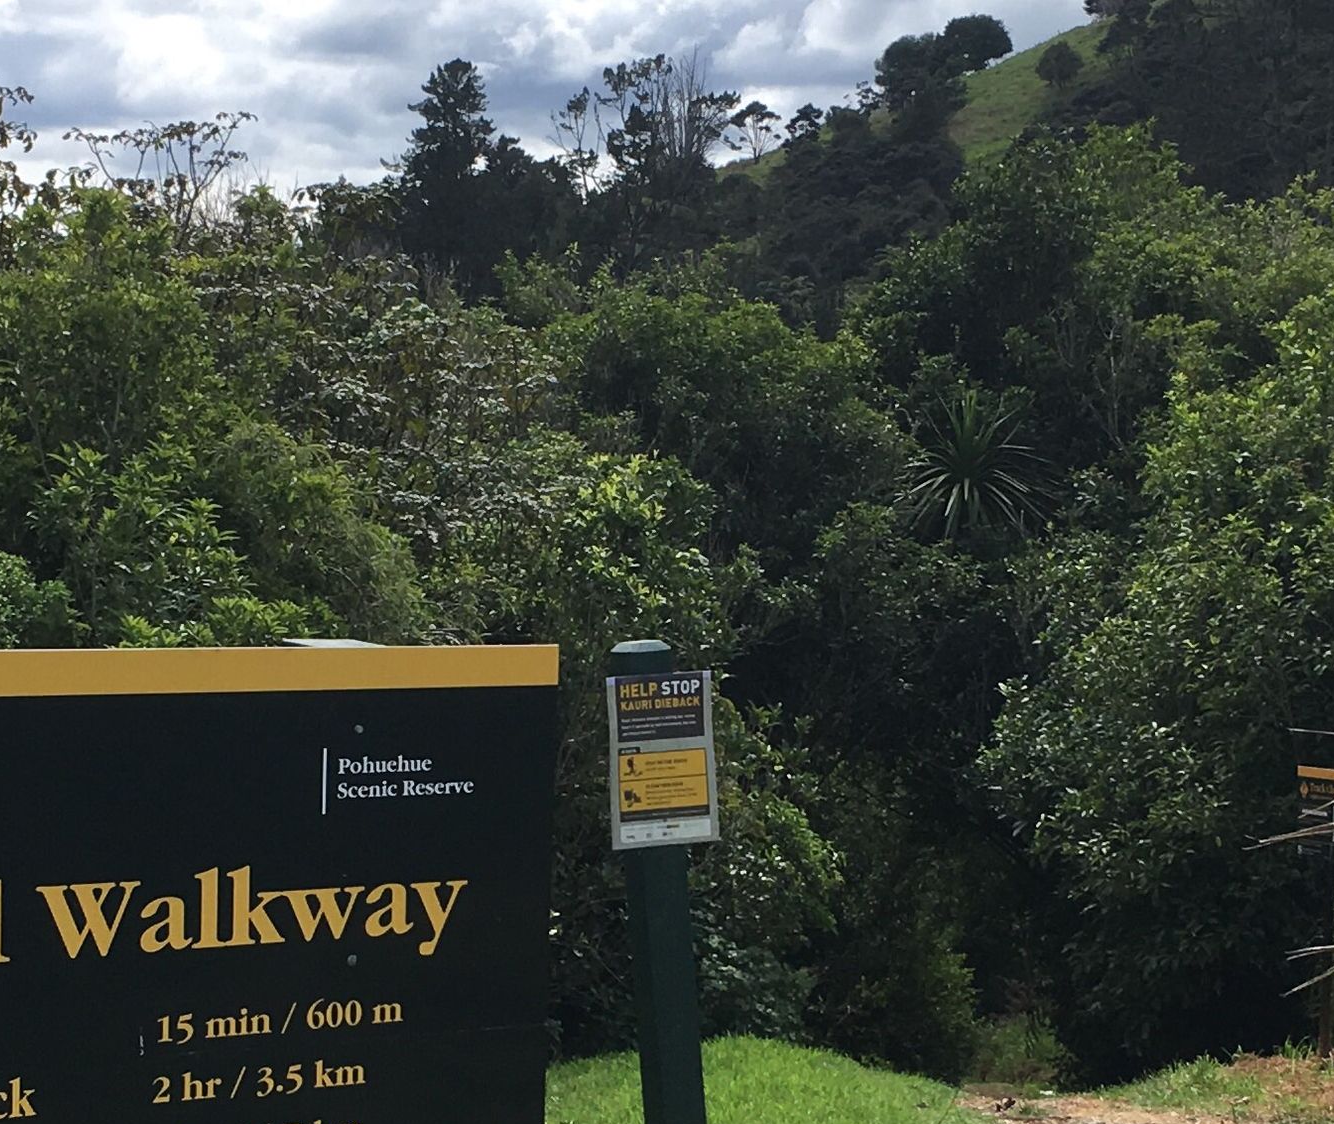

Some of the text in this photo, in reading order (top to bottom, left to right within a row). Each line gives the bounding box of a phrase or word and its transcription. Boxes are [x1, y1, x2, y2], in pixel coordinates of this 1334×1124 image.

[620, 679, 700, 698] HELP STOP
[620, 696, 700, 711] KAURI DIEBACK
[337, 754, 432, 775] Pohuehue
[337, 777, 474, 799] Scenic Reserve
[36, 866, 468, 956] Walkway
[157, 1000, 403, 1044] 15 min / 600 m
[152, 1060, 366, 1104] 2 hr / 3.5 km
